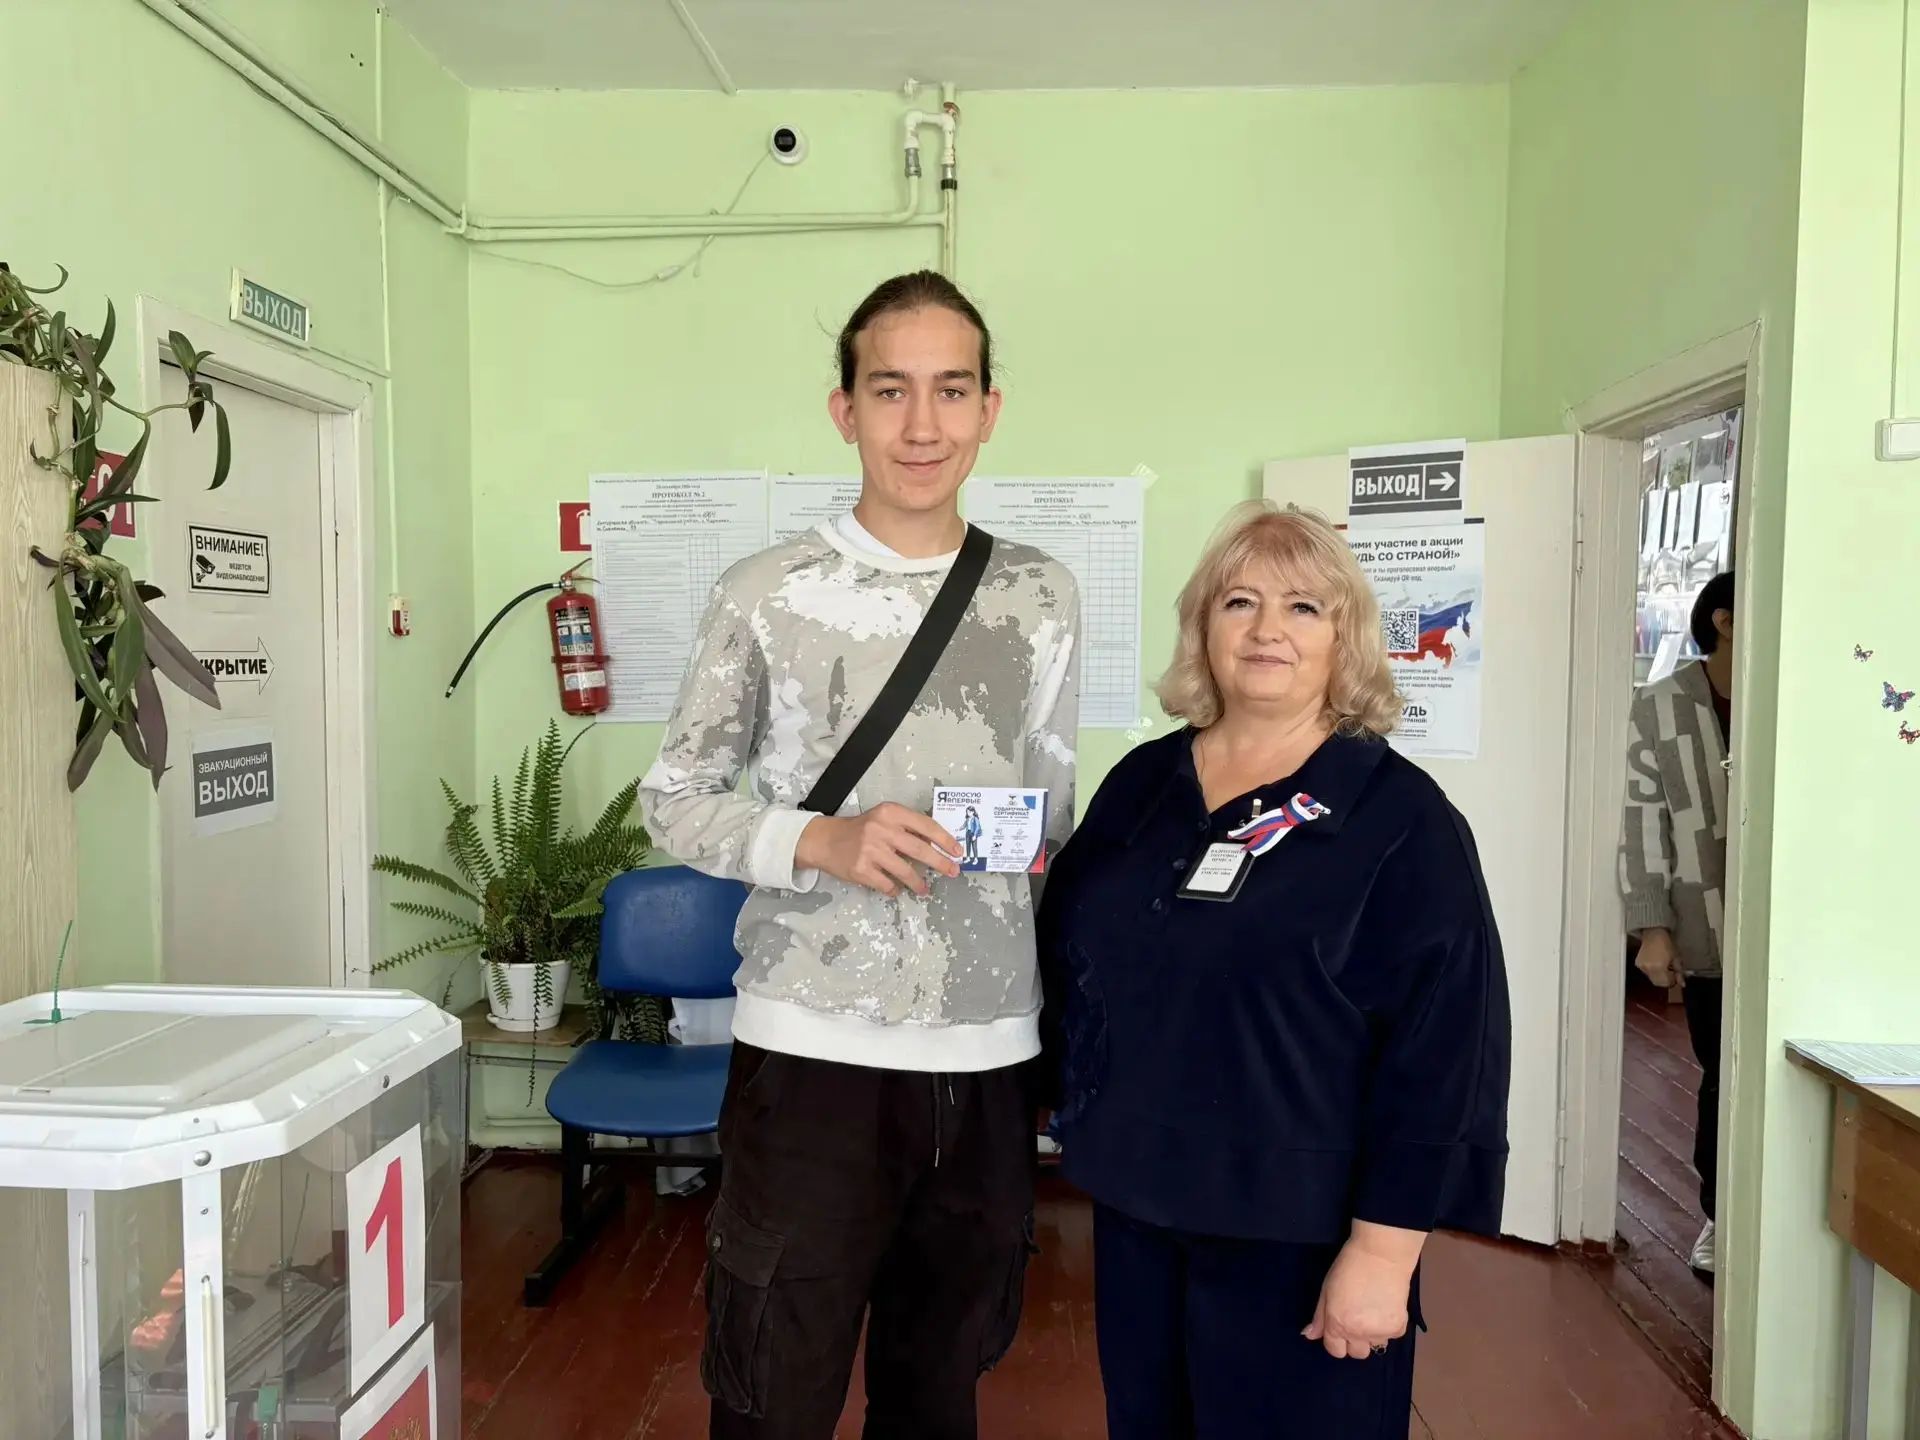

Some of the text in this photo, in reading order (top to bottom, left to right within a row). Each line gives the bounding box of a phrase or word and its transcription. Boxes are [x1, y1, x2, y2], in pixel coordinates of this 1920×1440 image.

[243, 285, 302, 339] ВЫХОД
[1354, 474, 1420, 496] ВЫХОД
[195, 535, 264, 557] ВНИМАНИЕ!
[1374, 540, 1418, 550] участие
[1430, 538, 1464, 547] акции
[1378, 552, 1394, 561] СО
[1396, 548, 1461, 561] СТРАНОЙ!»
[229, 563, 252, 571] ВЕДЕТСЯ
[216, 572, 265, 582] ВИДЕОНАБЛЮДЕНИЕ
[200, 659, 268, 675] КРЫТИЕ
[1402, 705, 1427, 717] УДЬ
[198, 752, 268, 774] ЭВАКУАЦИОННЫЙ
[199, 770, 269, 806] ВЫХОД
[937, 791, 947, 803] Я
[365, 1156, 405, 1329] 1
